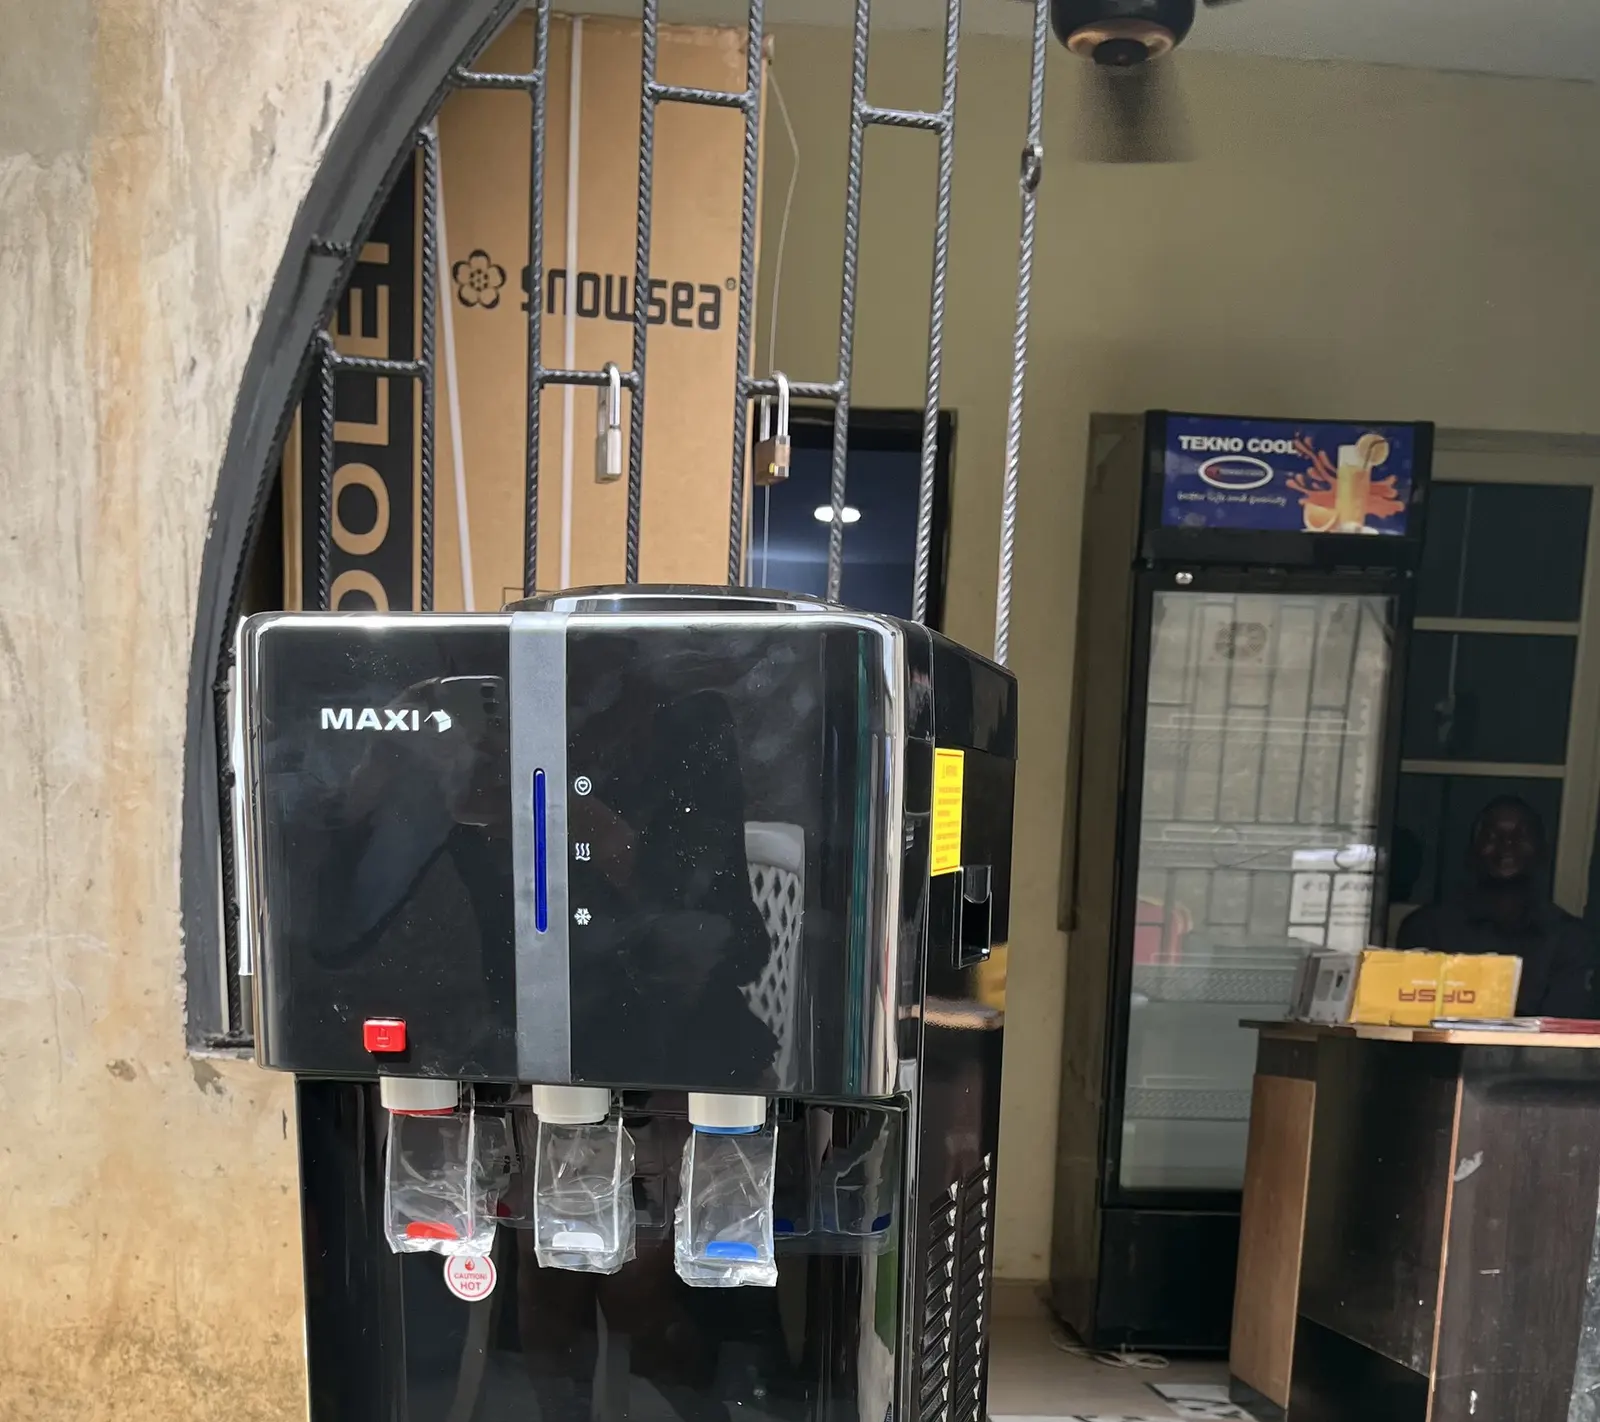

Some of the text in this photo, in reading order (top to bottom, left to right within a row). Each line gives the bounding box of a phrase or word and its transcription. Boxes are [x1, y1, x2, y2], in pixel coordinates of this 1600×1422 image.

[1179, 435, 1299, 454] TEKNO COOL
[321, 708, 420, 731] MAXI
[460, 1281, 482, 1291] HOT
